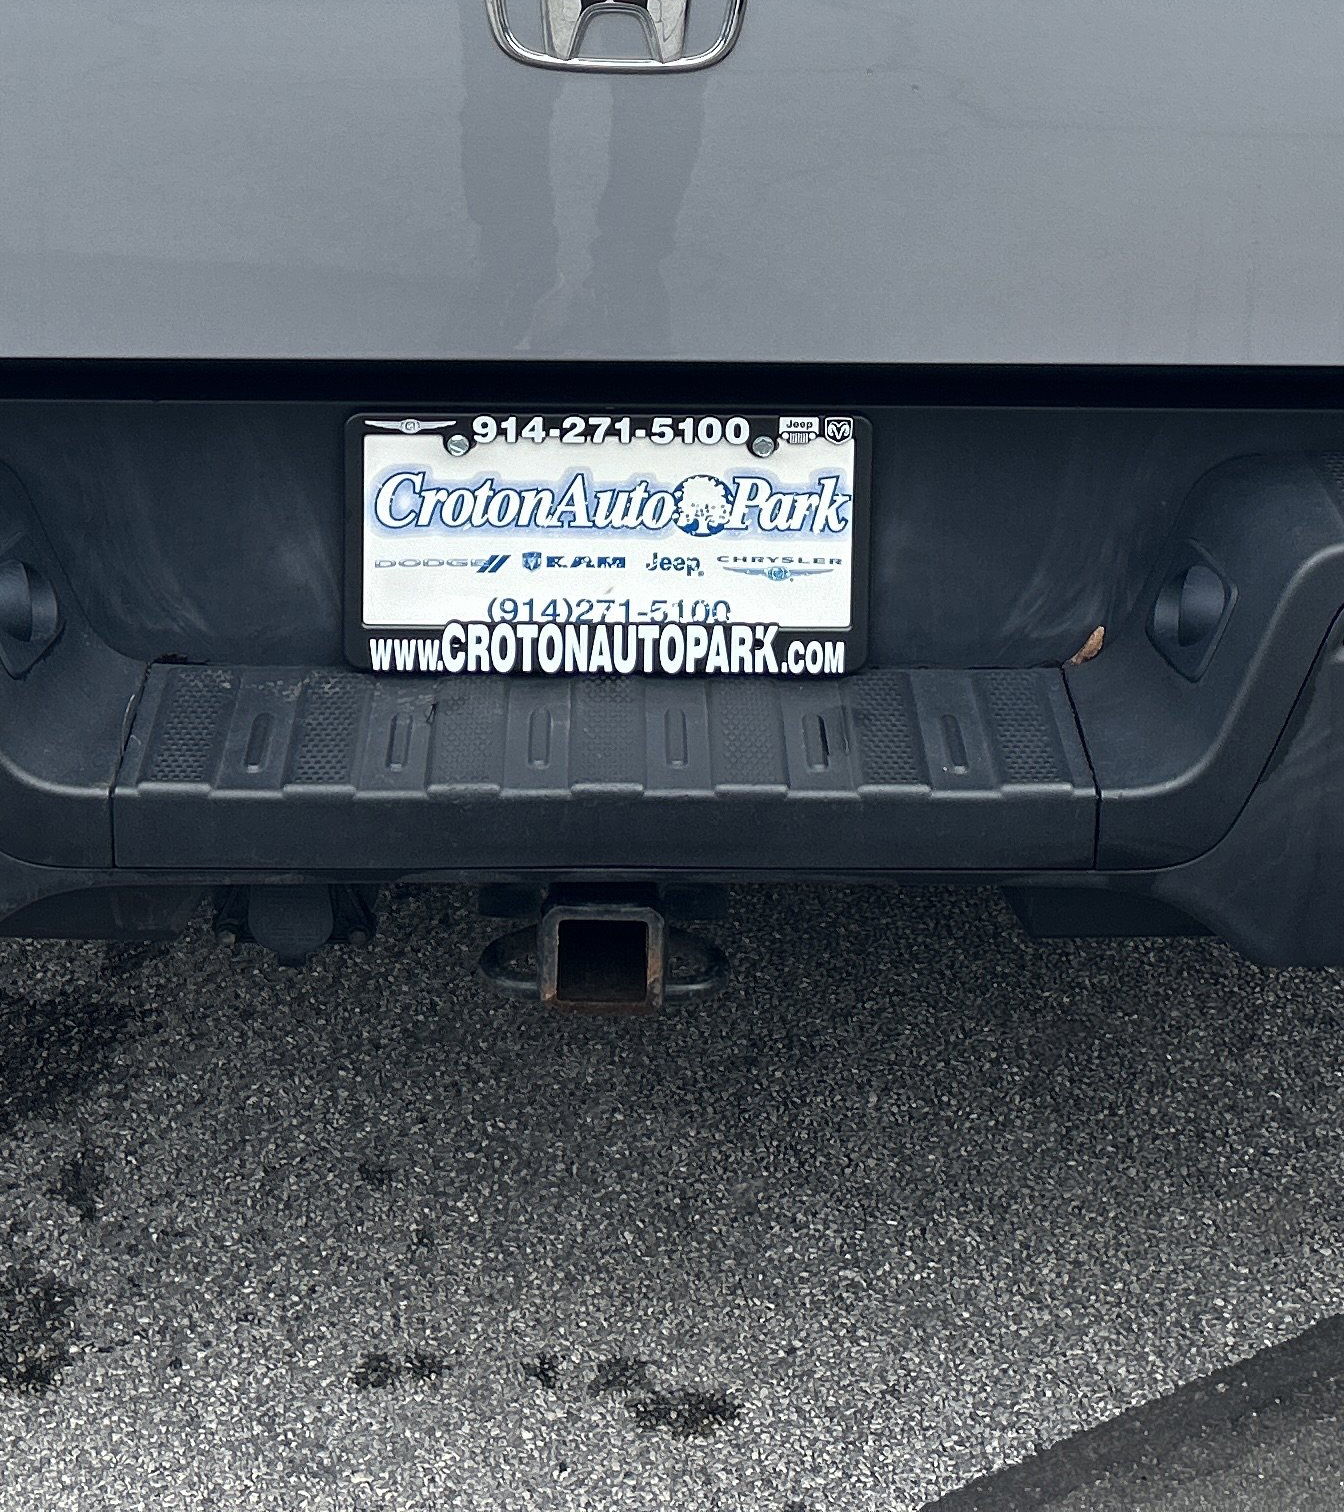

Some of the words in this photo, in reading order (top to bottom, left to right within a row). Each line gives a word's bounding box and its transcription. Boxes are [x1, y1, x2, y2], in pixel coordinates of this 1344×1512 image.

[471, 414, 751, 445] 914-271-5100
[785, 419, 813, 430] Jeep
[723, 475, 852, 535] Park
[374, 557, 492, 569] DODGE
[546, 555, 626, 569] RAM
[645, 551, 702, 577] Jeep
[716, 555, 843, 565] CHRYSLER
[487, 596, 732, 623] (914)271-5100
